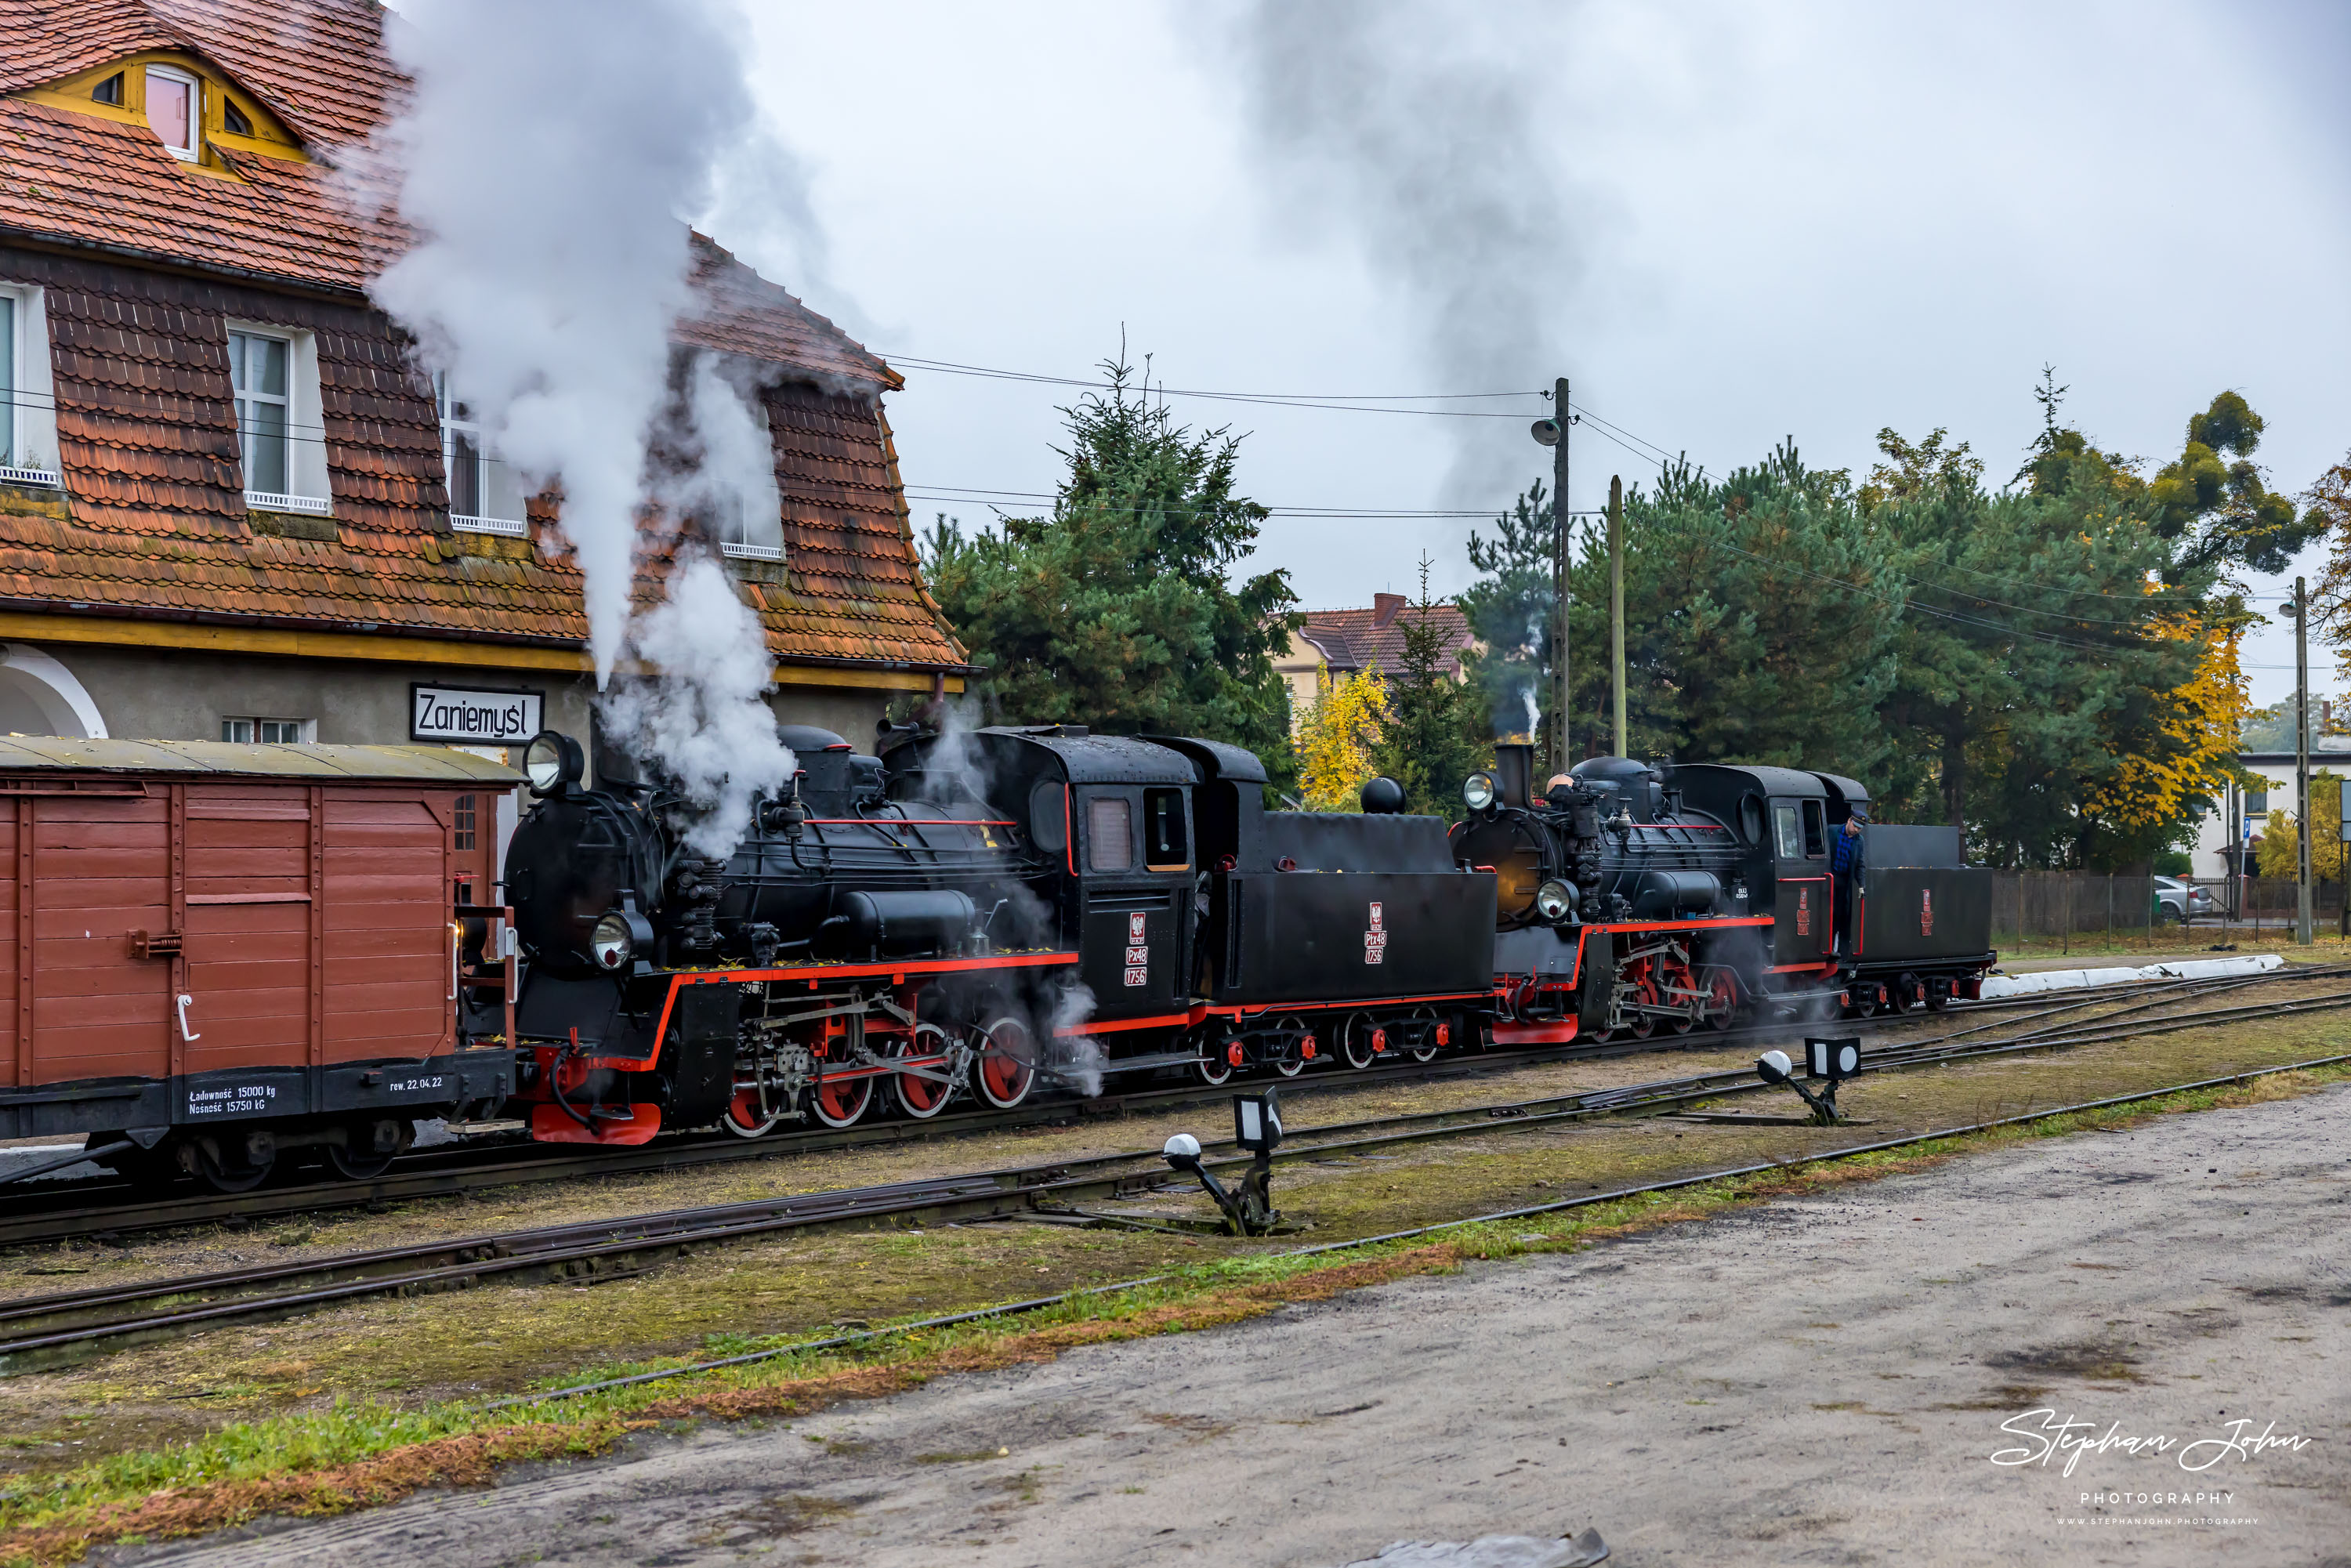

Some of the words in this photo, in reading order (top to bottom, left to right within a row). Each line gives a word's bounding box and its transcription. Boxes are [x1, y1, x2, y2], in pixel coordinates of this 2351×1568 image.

[418, 694, 527, 737] Zaniemyśl
[2244, 820, 2249, 836] P
[1366, 932, 1386, 945] Ptx48
[1128, 949, 1147, 962] Px48
[1367, 949, 1382, 961] 1756
[1128, 969, 1145, 983] 1756
[189, 1088, 232, 1102] Ładowność
[237, 1086, 264, 1098] 15000
[266, 1085, 276, 1098] kg
[189, 1102, 223, 1114] Nośność
[226, 1100, 252, 1112] 15750
[255, 1099, 265, 1110] kG
